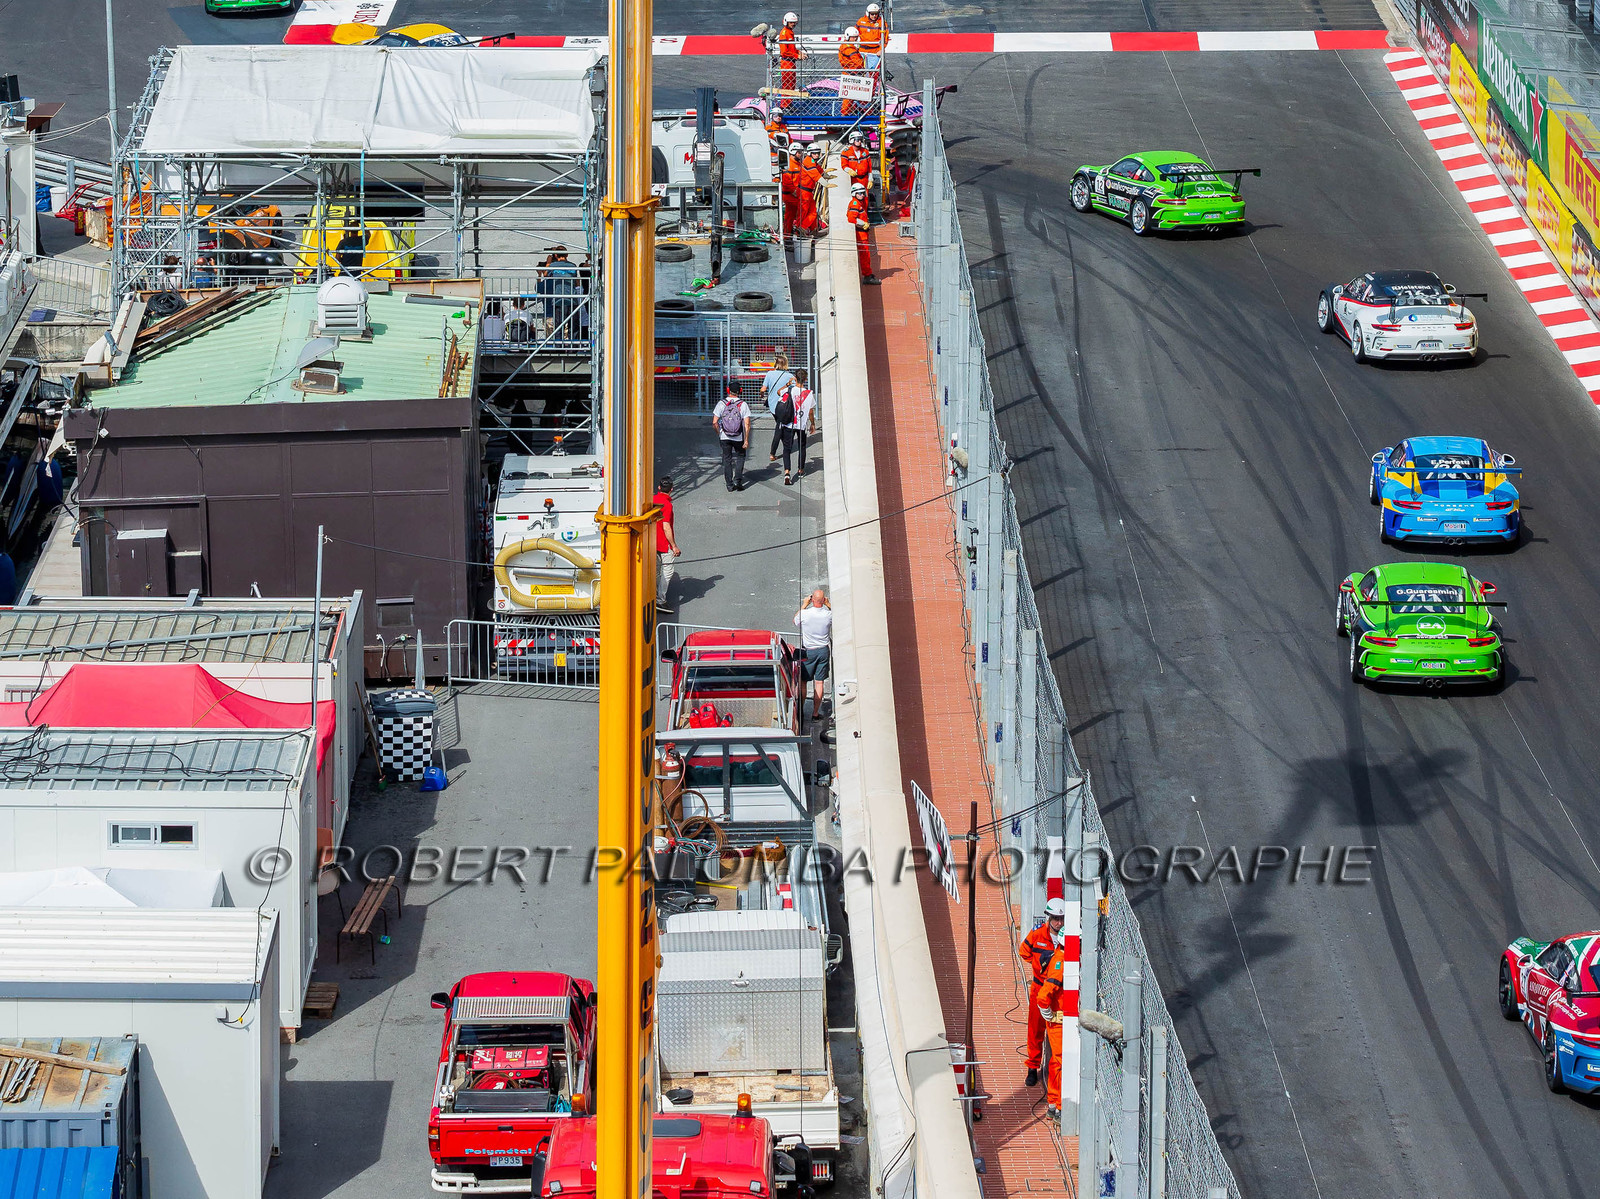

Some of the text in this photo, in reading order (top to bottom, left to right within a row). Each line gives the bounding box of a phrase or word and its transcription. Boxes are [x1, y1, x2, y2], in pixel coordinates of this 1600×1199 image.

[351, 9, 381, 23] UBS
[1482, 17, 1529, 134] Heineken
[842, 84, 871, 93] INTERVENTION
[498, 1156, 521, 1164] P935
